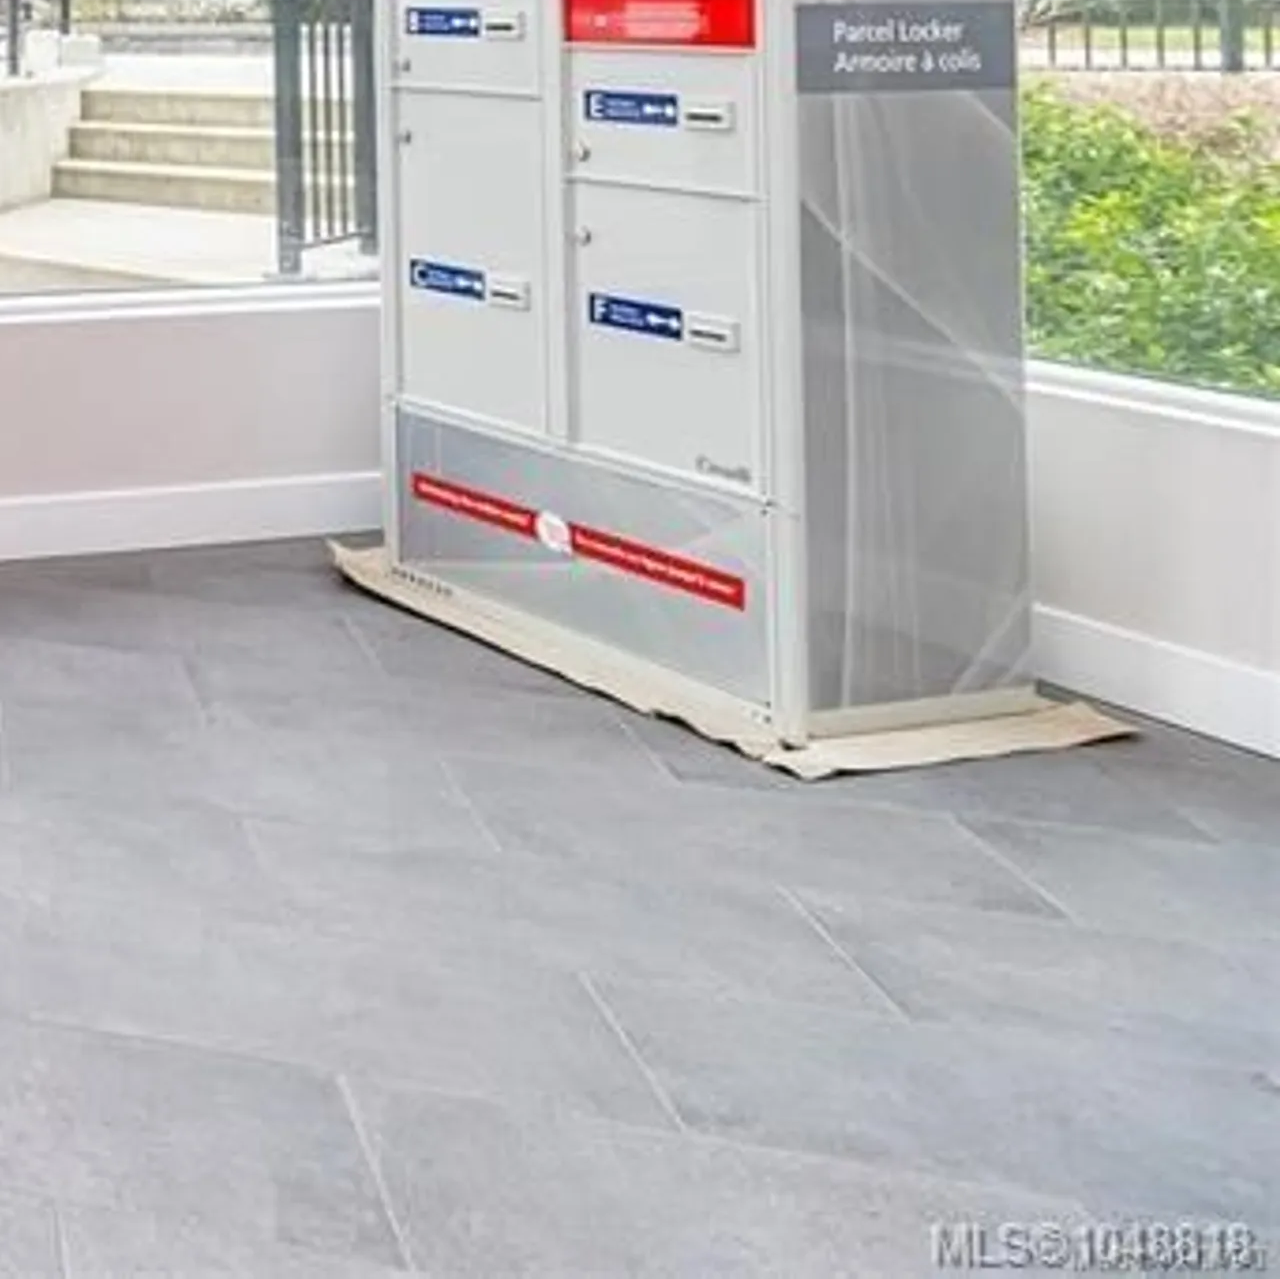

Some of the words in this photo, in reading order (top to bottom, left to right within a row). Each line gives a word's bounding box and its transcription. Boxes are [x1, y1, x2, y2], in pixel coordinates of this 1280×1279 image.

[833, 18, 895, 44] Parcel
[897, 18, 965, 43] Locker
[833, 49, 919, 73] Armoire
[920, 47, 935, 73] à
[938, 48, 983, 73] colis
[590, 94, 605, 118] E
[413, 261, 430, 287] C
[593, 297, 610, 322] F
